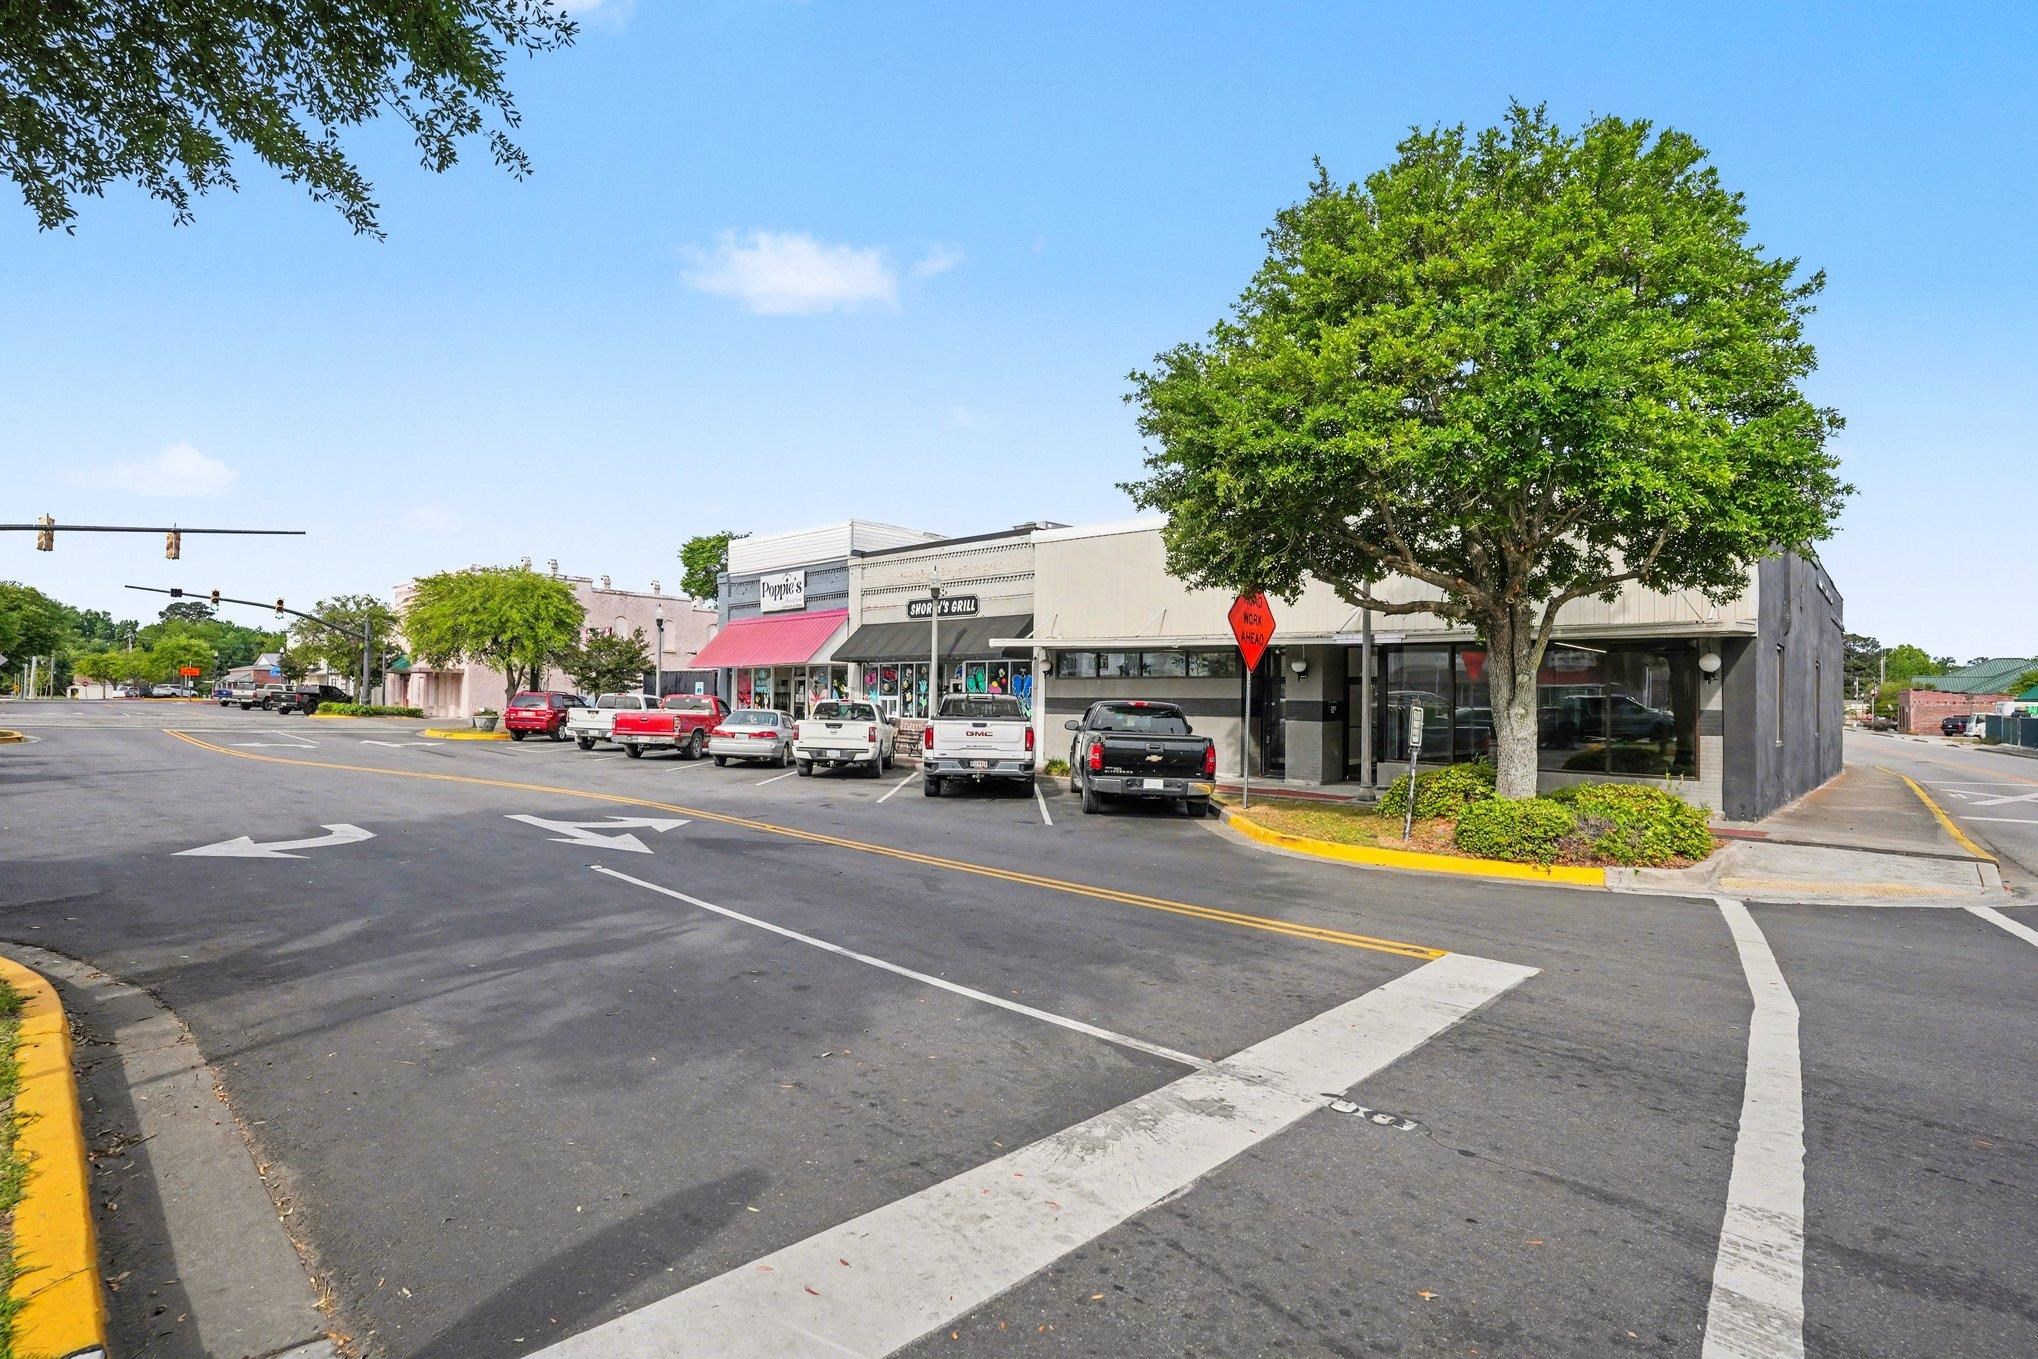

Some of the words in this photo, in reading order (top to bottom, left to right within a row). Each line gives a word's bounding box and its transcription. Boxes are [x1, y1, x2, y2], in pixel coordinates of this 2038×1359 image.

[762, 576, 803, 601] Poppie's
[910, 600, 950, 616] SHORY'S
[951, 599, 976, 613] GRILL
[1243, 612, 1263, 627] WORK
[1241, 630, 1264, 646] AHEAD
